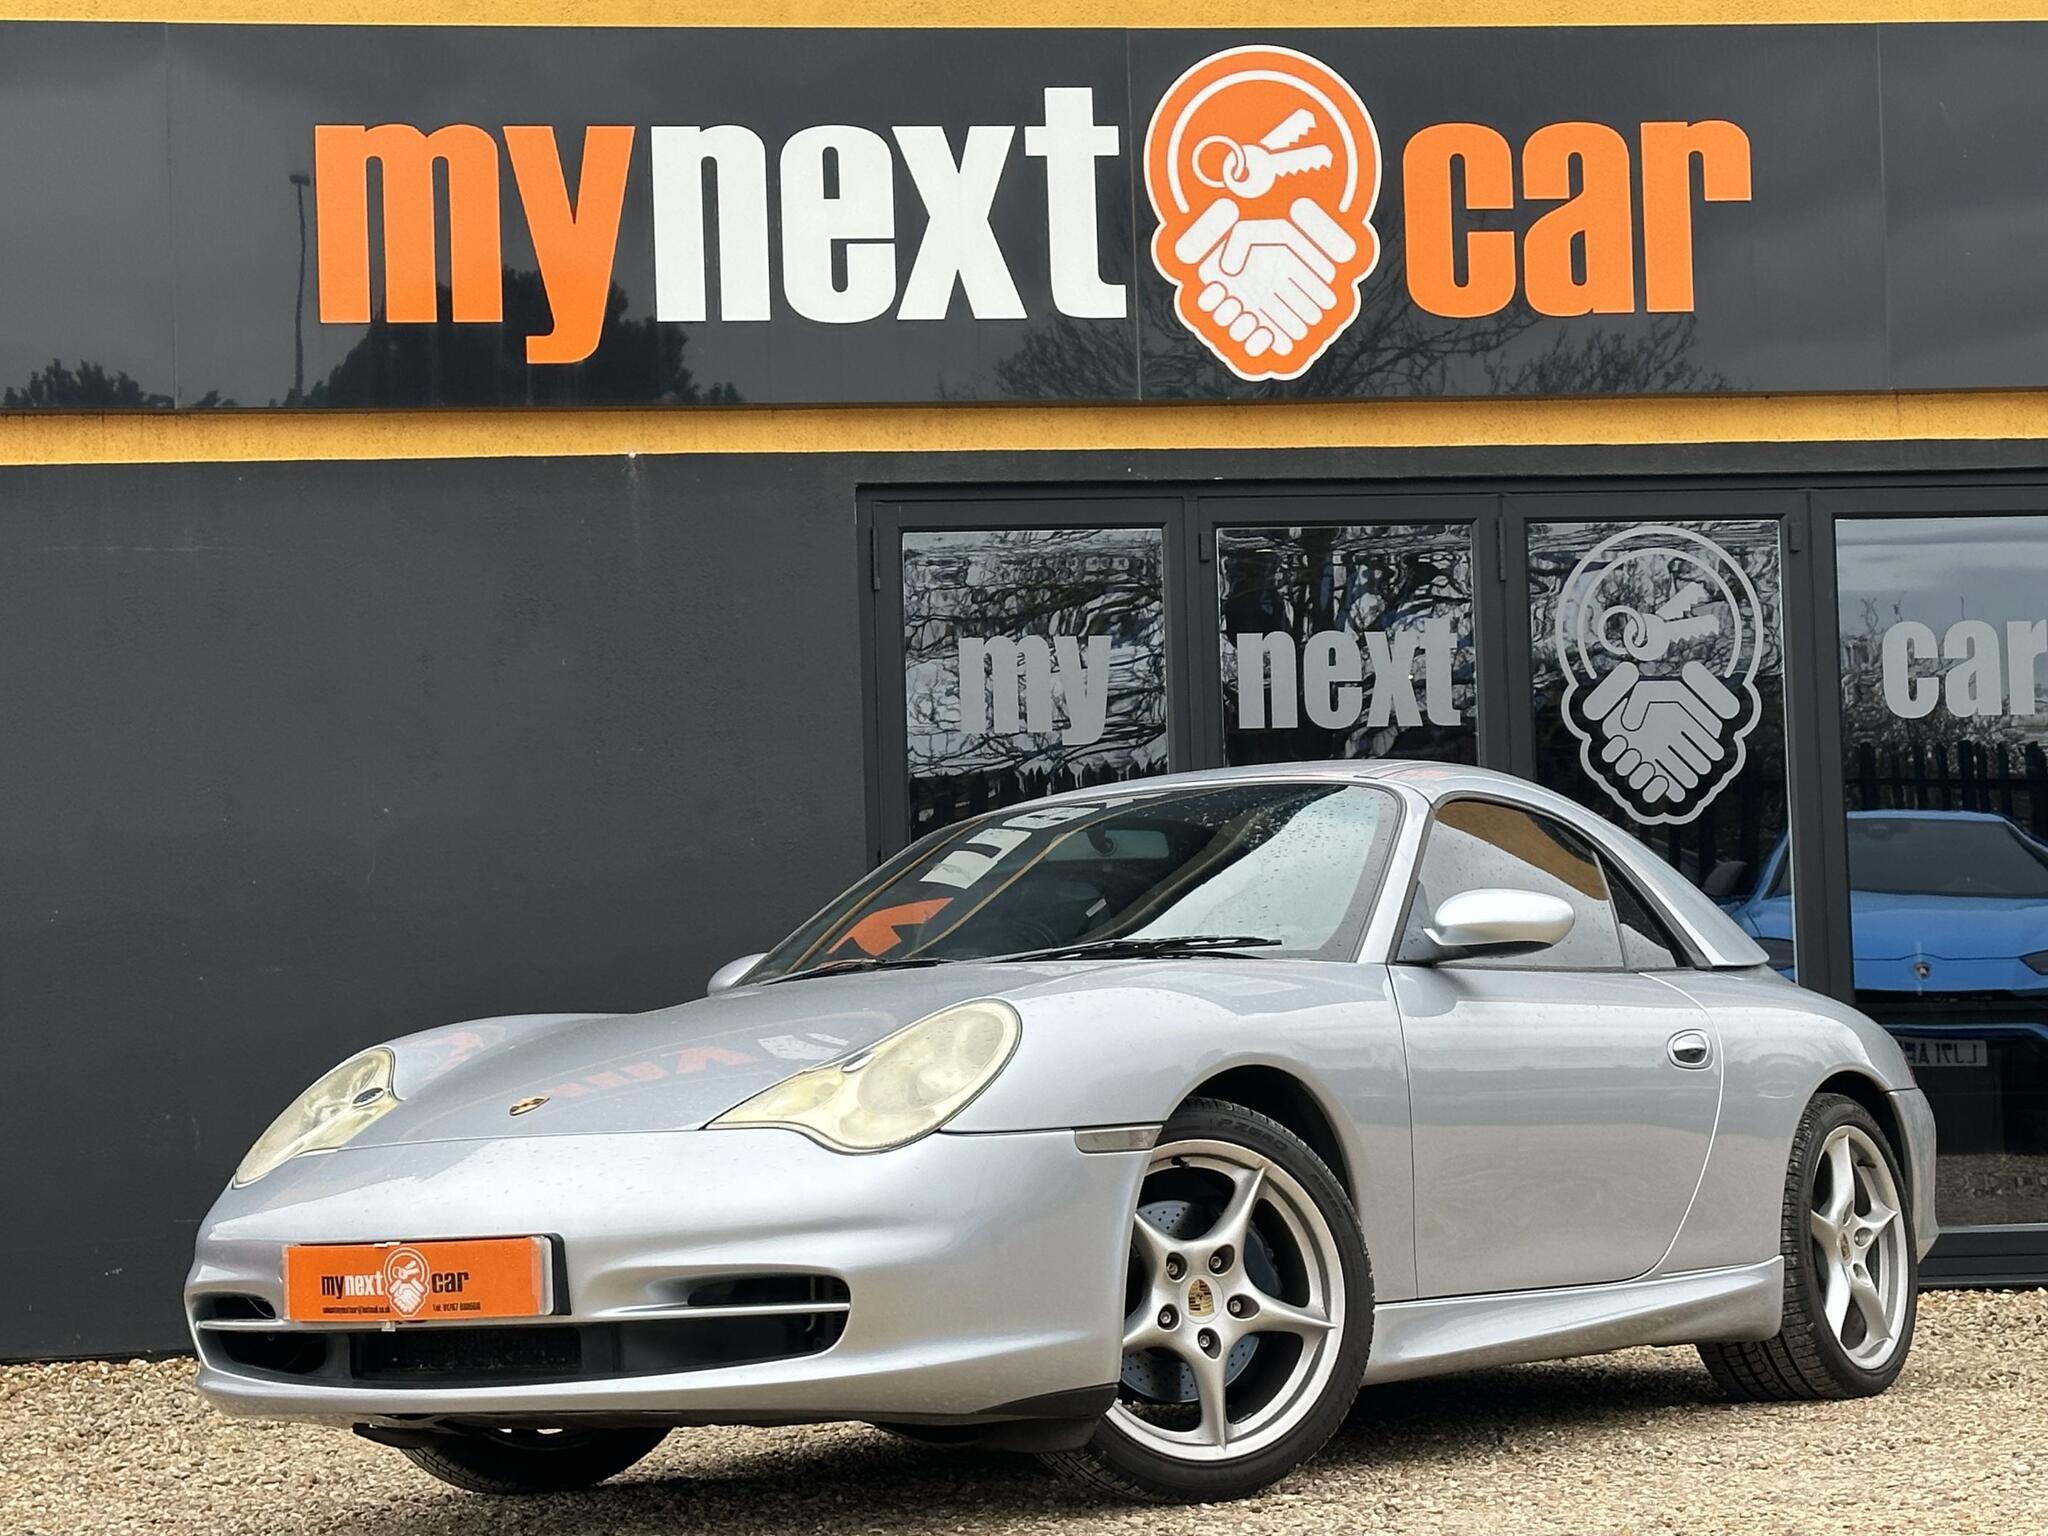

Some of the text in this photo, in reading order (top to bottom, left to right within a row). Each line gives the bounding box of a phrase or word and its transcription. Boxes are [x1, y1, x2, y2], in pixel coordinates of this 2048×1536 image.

[1403, 120, 1752, 317] car
[958, 618, 2048, 746] my next car
[431, 1271, 469, 1293] car
